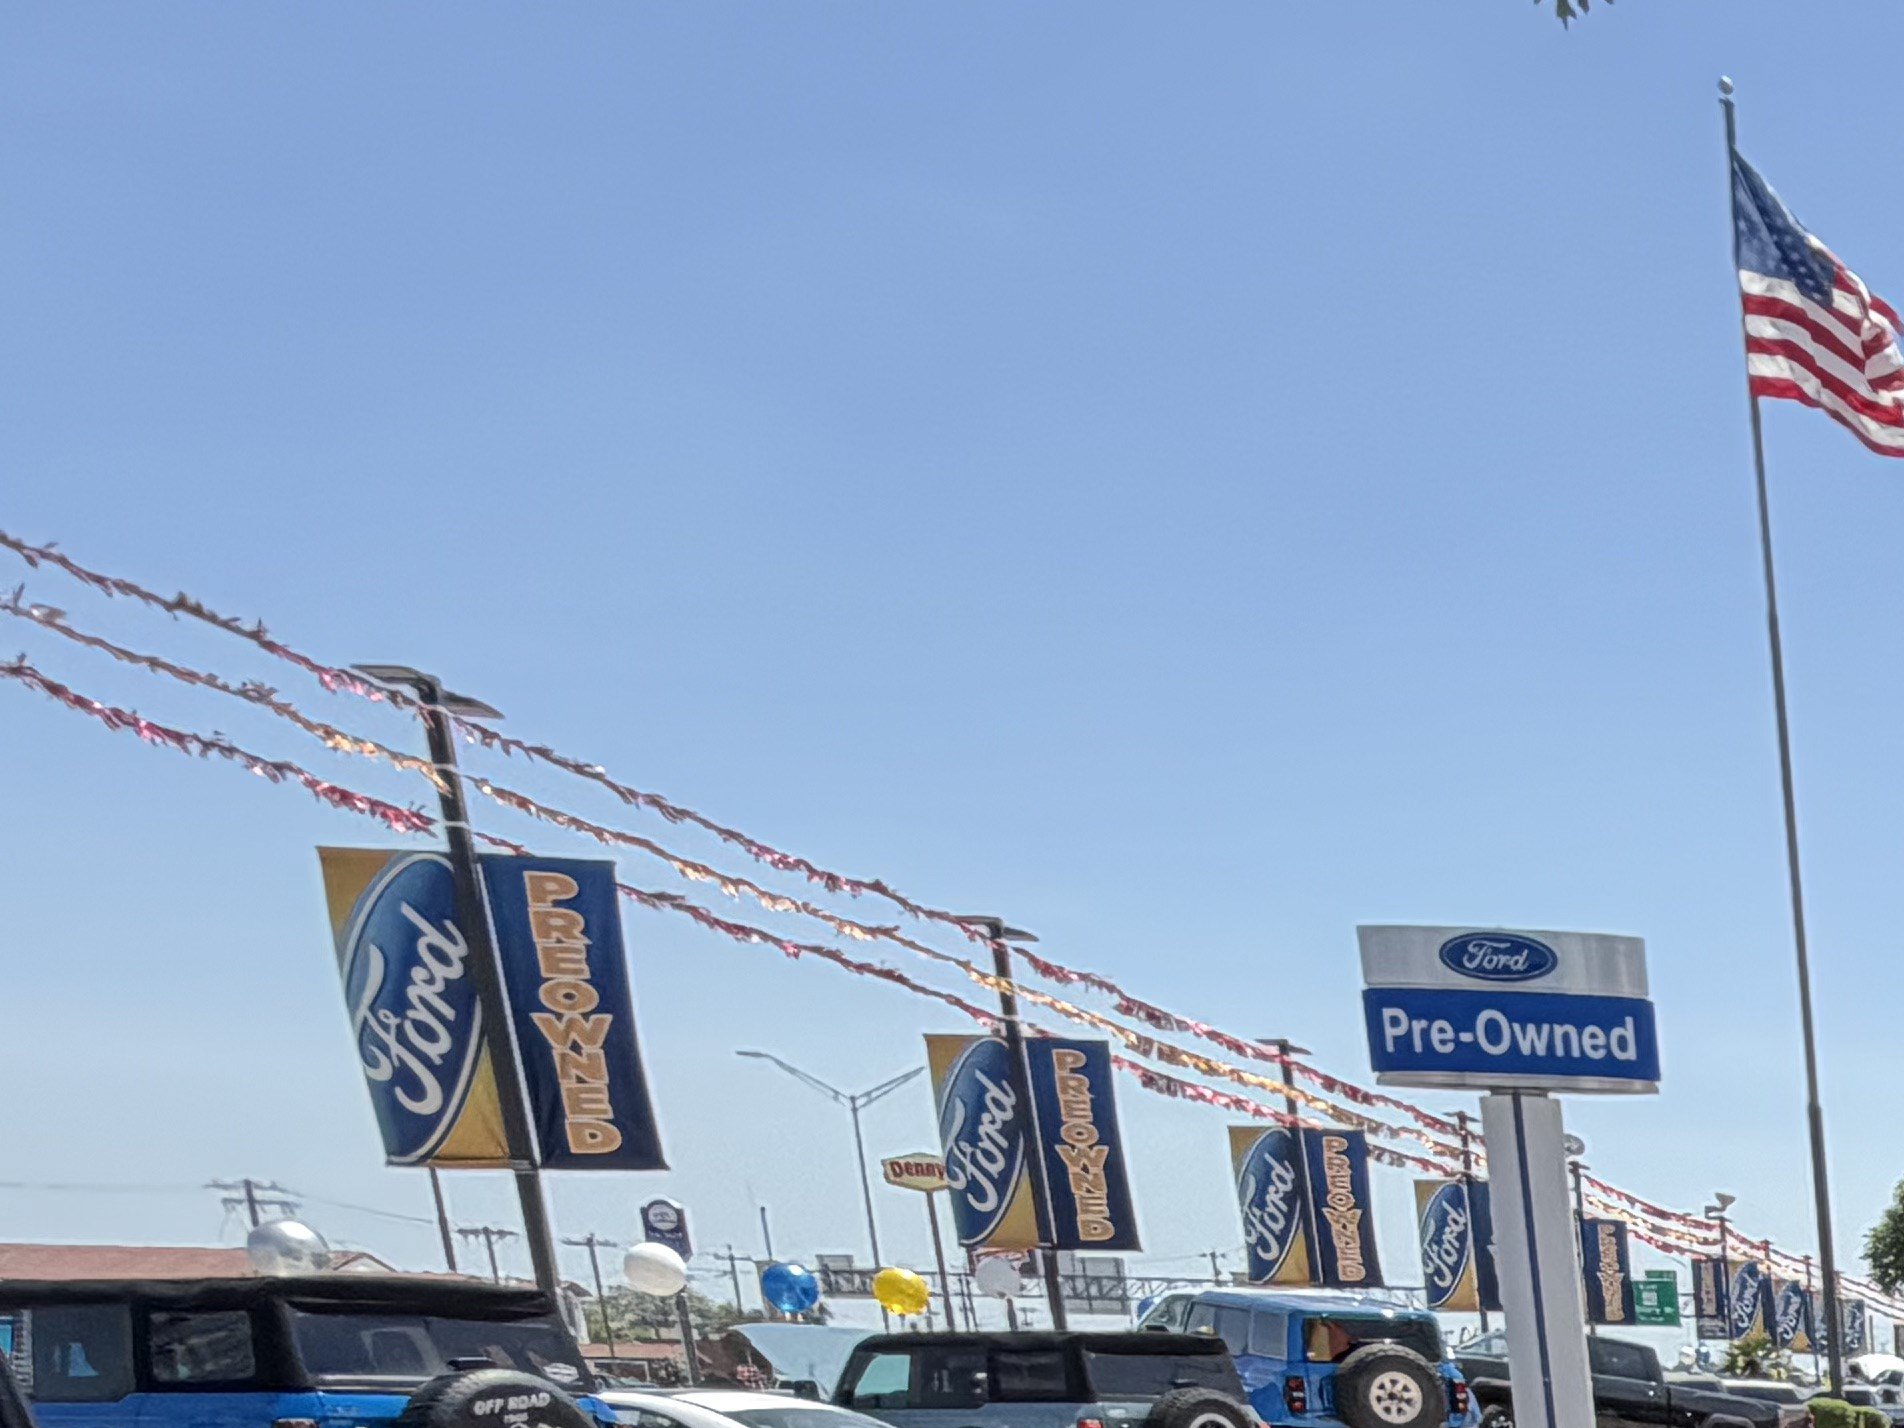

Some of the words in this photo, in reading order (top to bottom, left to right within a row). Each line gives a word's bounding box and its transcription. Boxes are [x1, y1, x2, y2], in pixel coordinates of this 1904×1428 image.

[1462, 937, 1530, 972] Ford
[352, 903, 469, 1115] Ford
[523, 869, 623, 1155] PREOWNED
[1381, 1007, 1638, 1062] Pre-Owned
[889, 1160, 946, 1180] Denny
[944, 1069, 1017, 1213] Ford
[1240, 1152, 1296, 1261] Ford
[1423, 1200, 1467, 1288] Ford
[472, 1398, 505, 1417] OFF
[506, 1392, 552, 1411] ROAD
